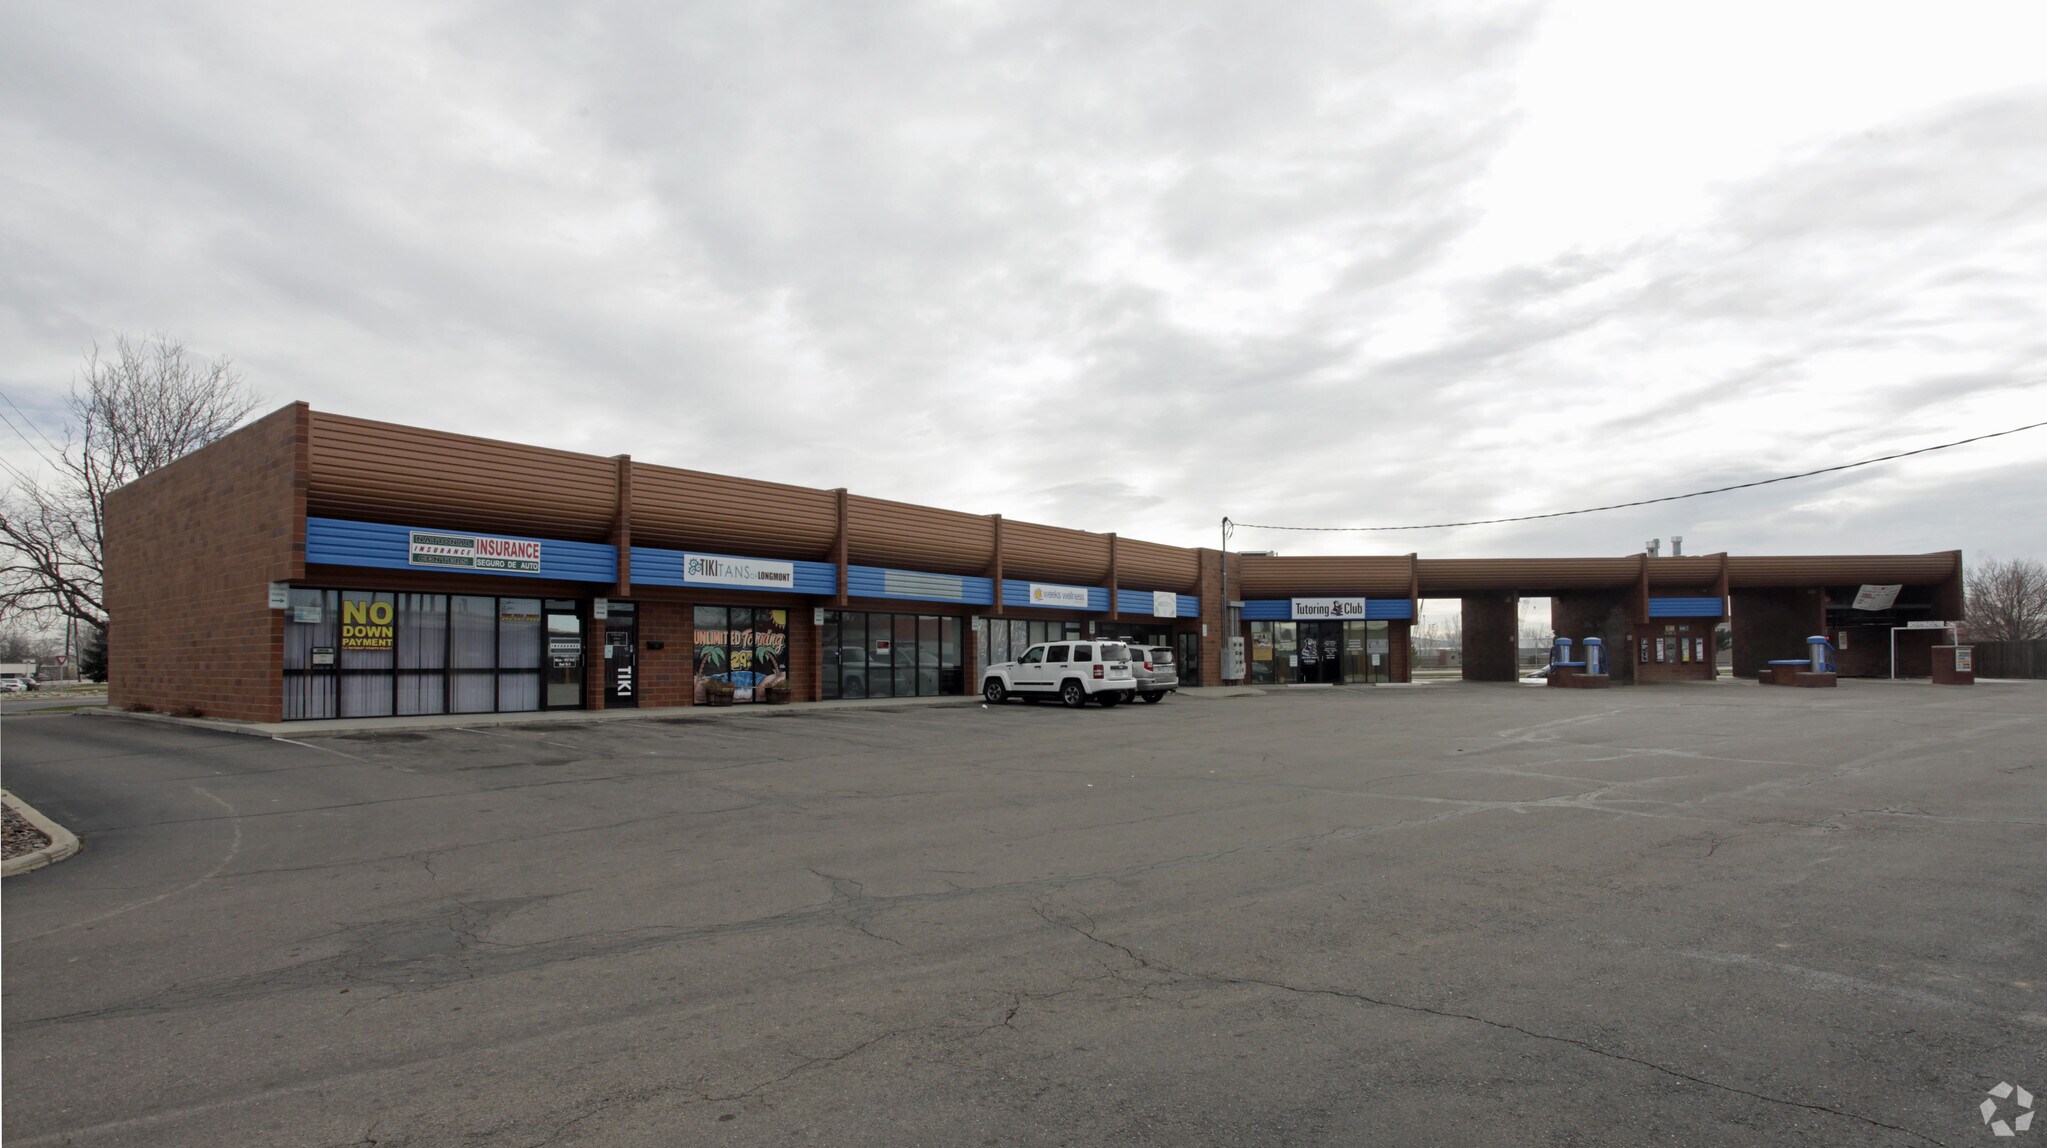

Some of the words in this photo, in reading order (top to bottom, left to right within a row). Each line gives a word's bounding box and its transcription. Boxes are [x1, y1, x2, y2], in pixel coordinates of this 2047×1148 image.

[414, 545, 471, 556] INSURANCE
[476, 538, 540, 559] INSURANCE
[477, 559, 505, 568] SEGURO
[507, 561, 517, 569] DE
[520, 562, 539, 570] AUTO
[700, 558, 718, 577] TIKI
[718, 563, 751, 580] TANS
[757, 571, 790, 582] LONGMONT
[343, 600, 393, 625] NO
[1296, 602, 1329, 617] Tutoring
[1344, 602, 1363, 615] Club
[343, 626, 393, 637] DOWN
[342, 638, 393, 646] PAYMENT
[617, 665, 632, 696] TIKI
